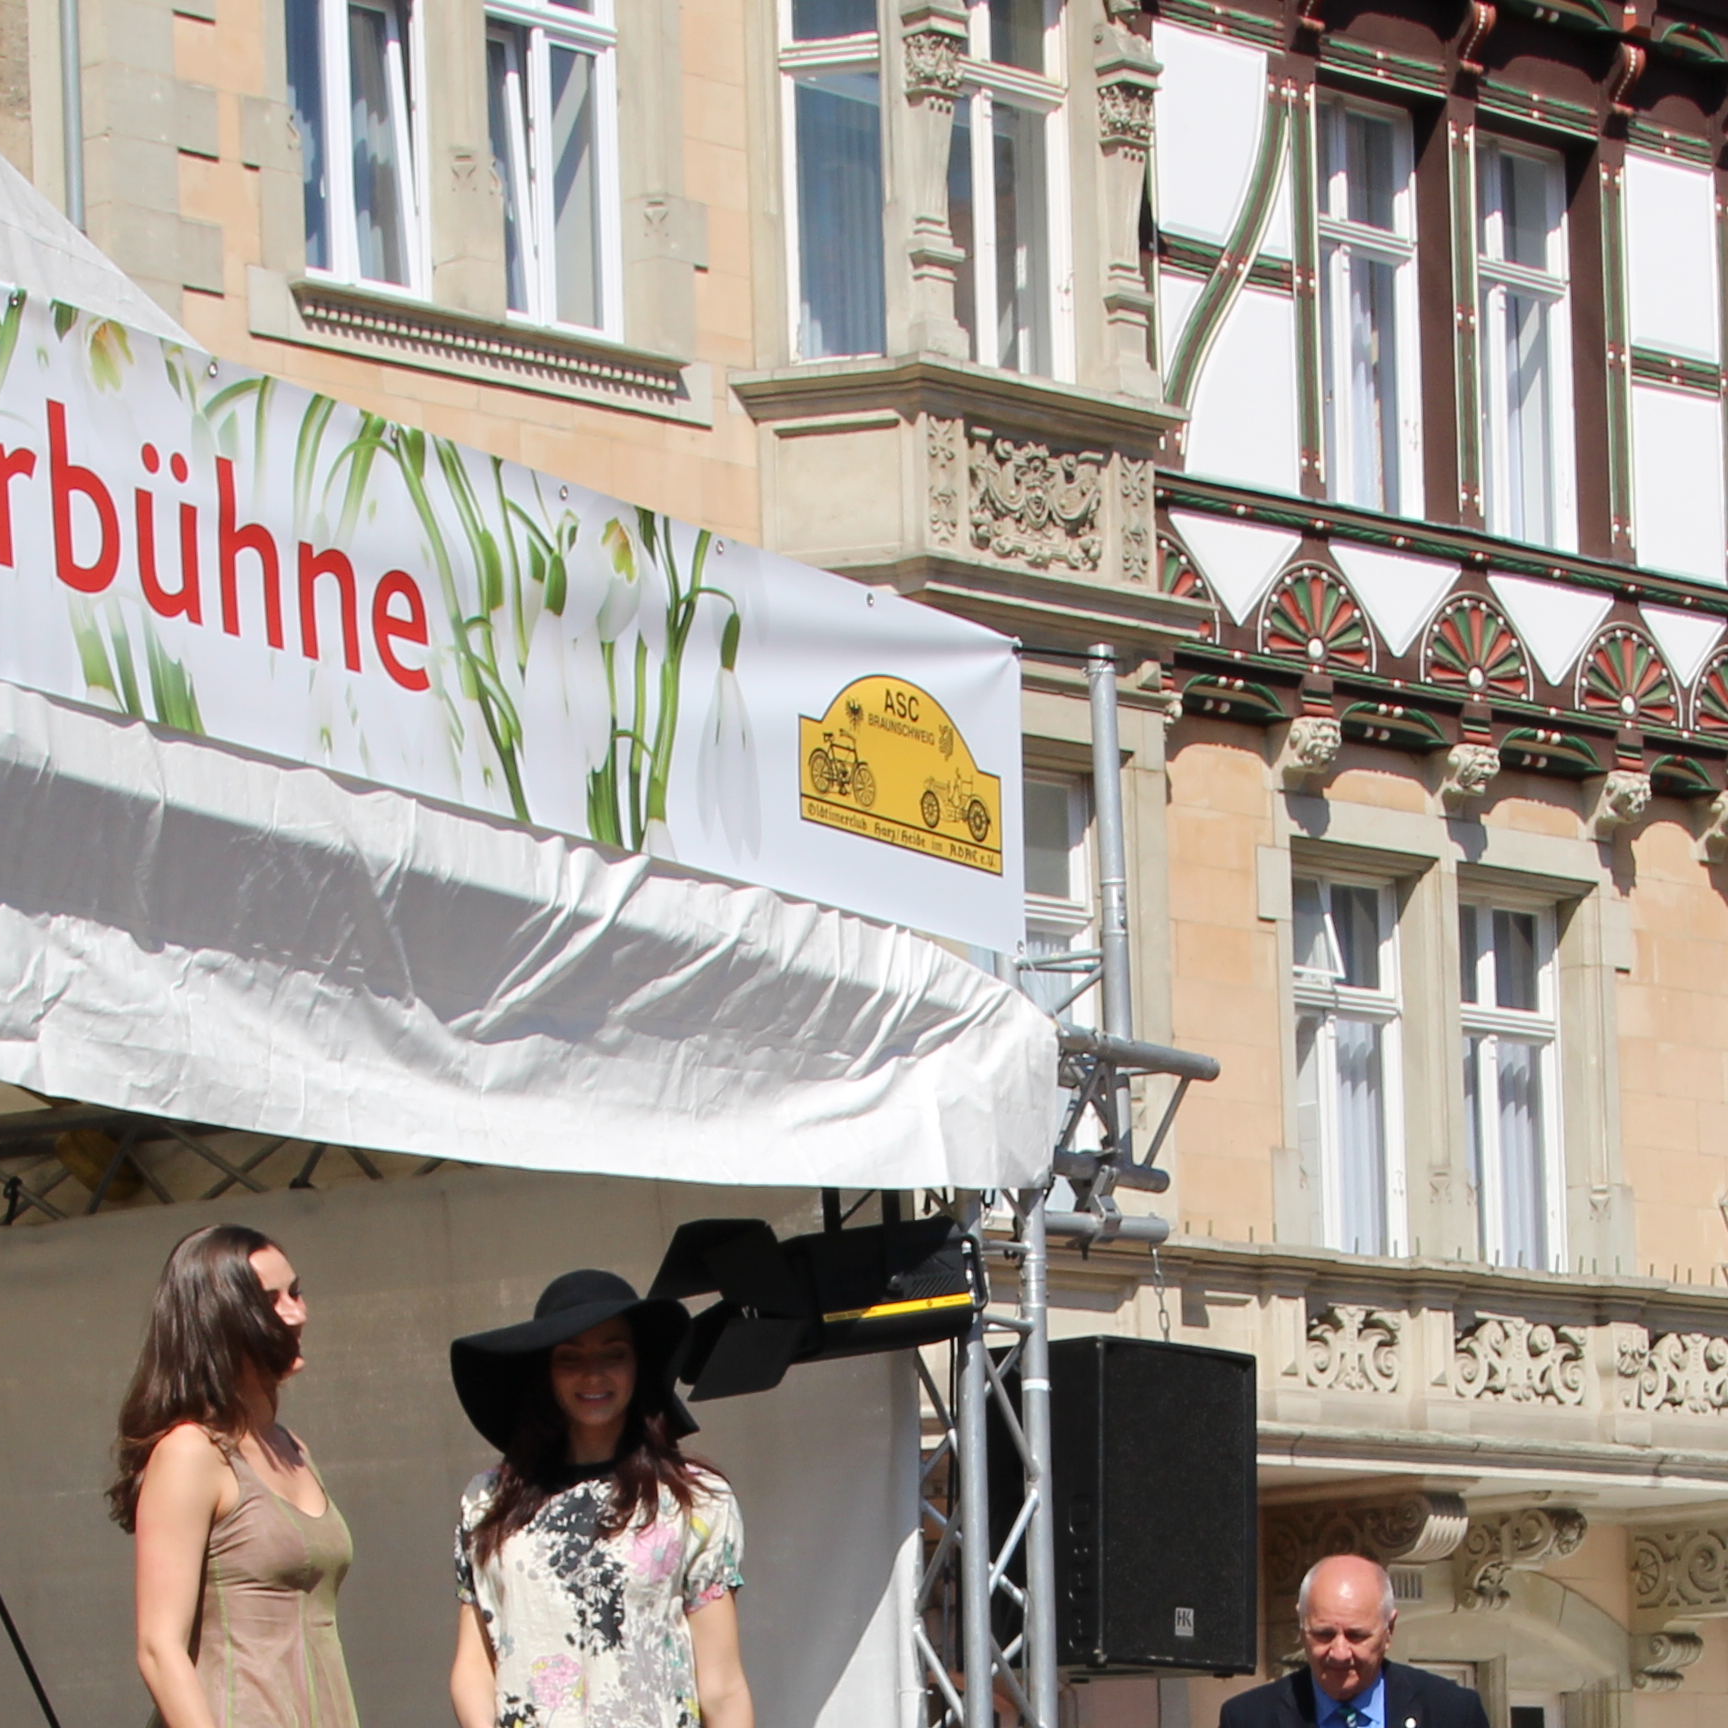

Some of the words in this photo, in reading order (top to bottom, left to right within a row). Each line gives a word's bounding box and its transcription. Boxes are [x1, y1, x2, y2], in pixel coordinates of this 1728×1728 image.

[883, 687, 920, 722] ASC
[868, 712, 936, 746] BRAUNSCHWEIG
[1177, 1610, 1193, 1628] HK
